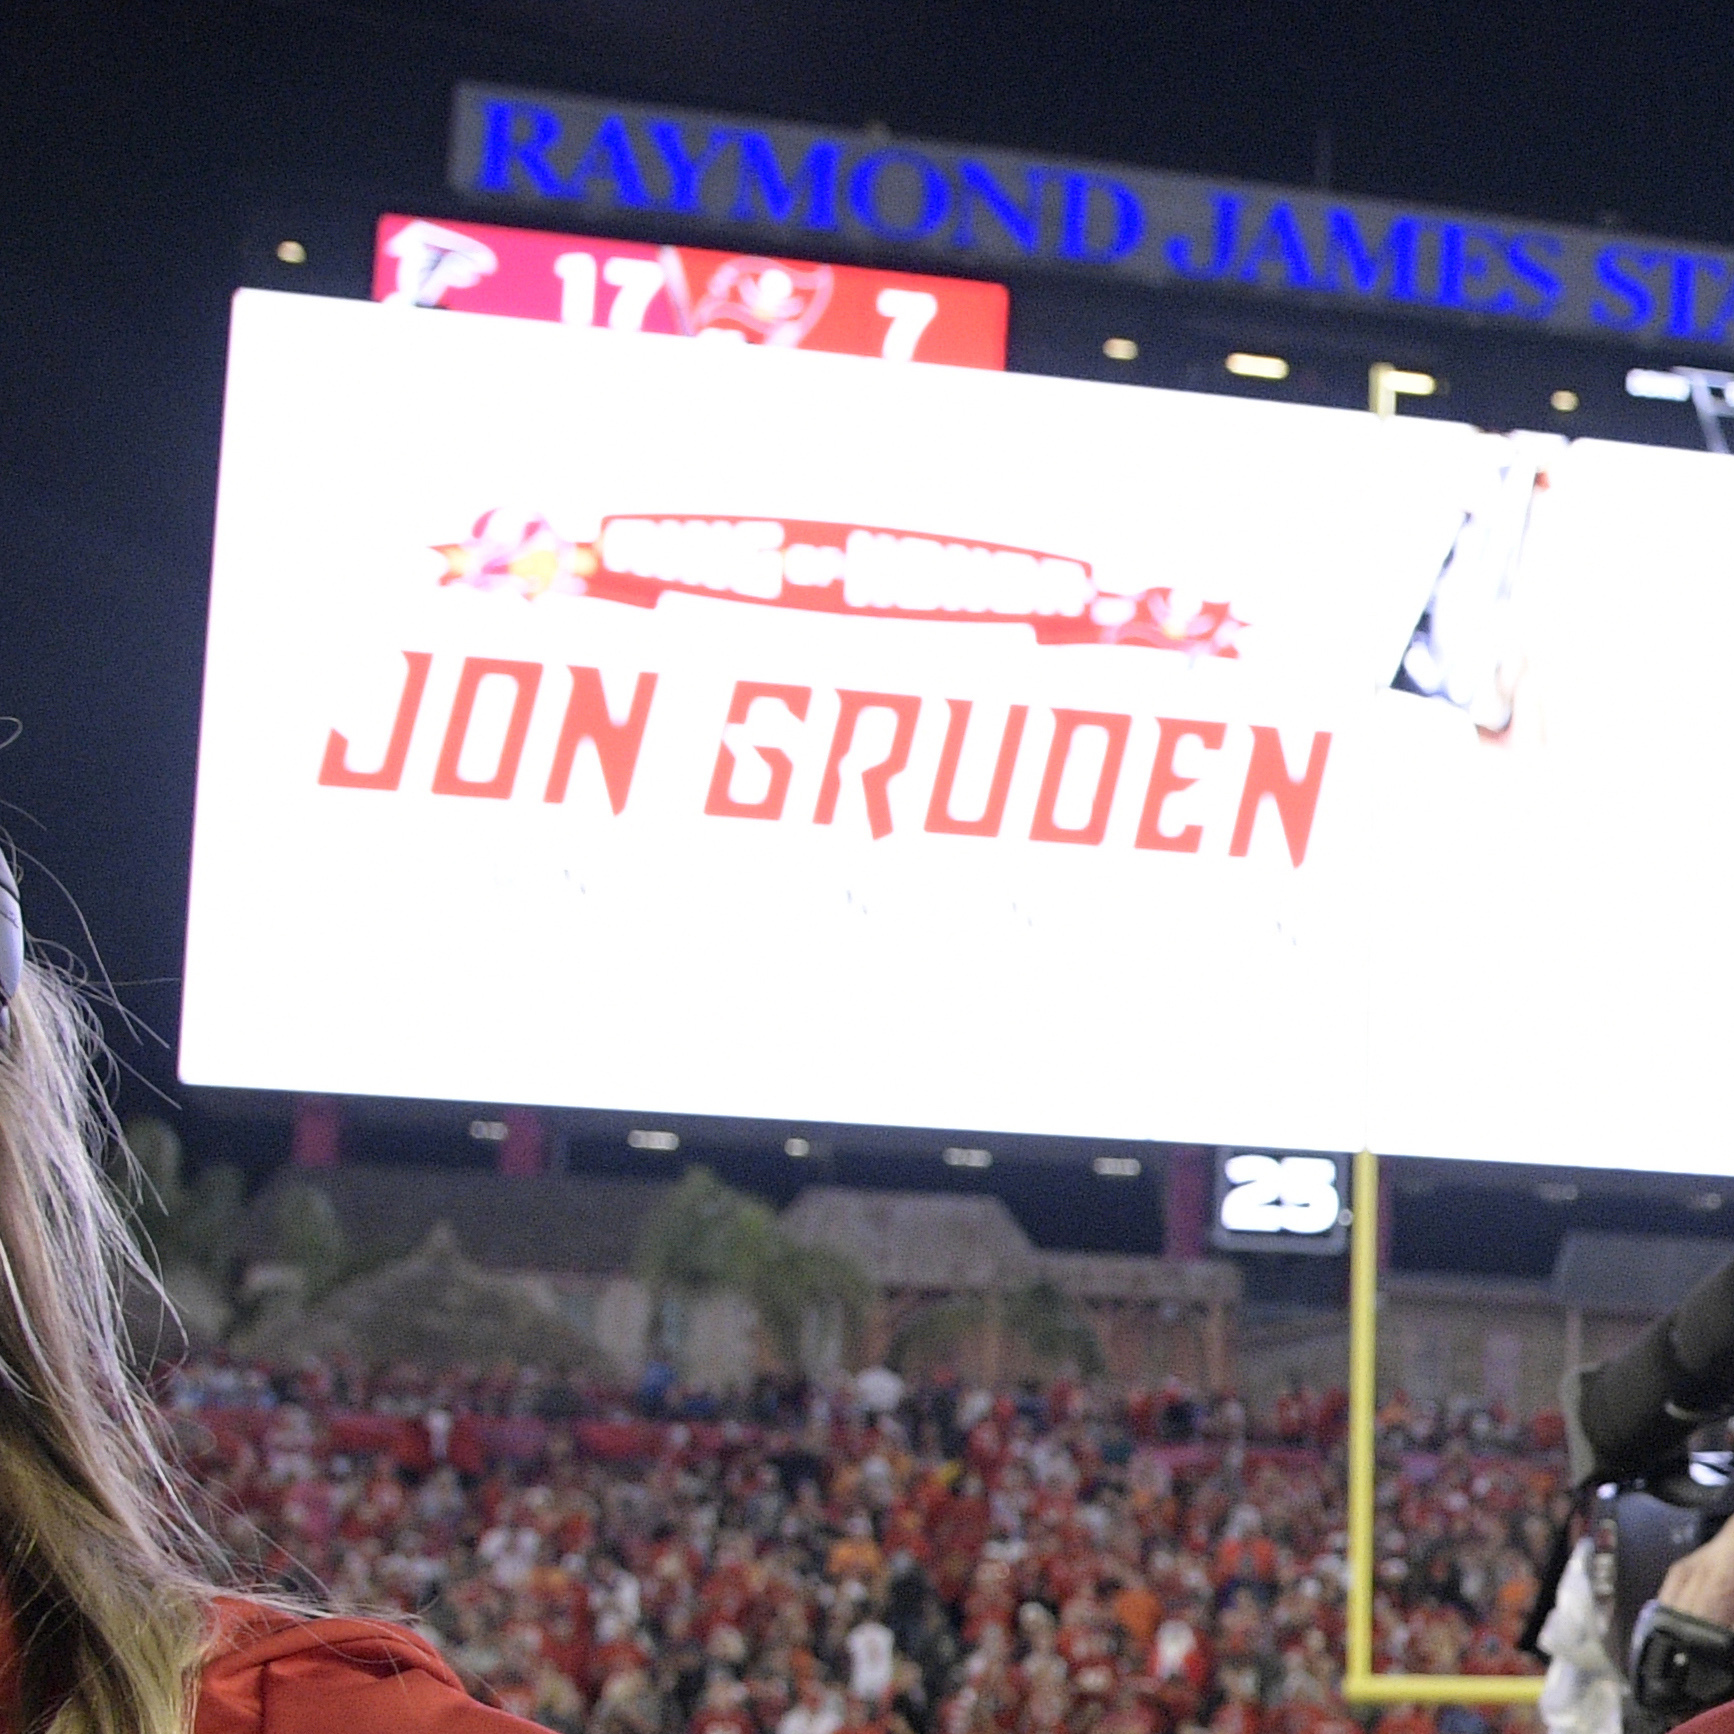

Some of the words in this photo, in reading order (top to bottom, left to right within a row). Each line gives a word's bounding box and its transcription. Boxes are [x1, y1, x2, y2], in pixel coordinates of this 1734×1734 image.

[476, 97, 1149, 264] RAYMOND
[1165, 188, 1567, 319] JAMES
[554, 252, 660, 334] 17
[876, 288, 938, 361] 7
[318, 650, 658, 815] JON
[703, 679, 1332, 868] GRUDEN
